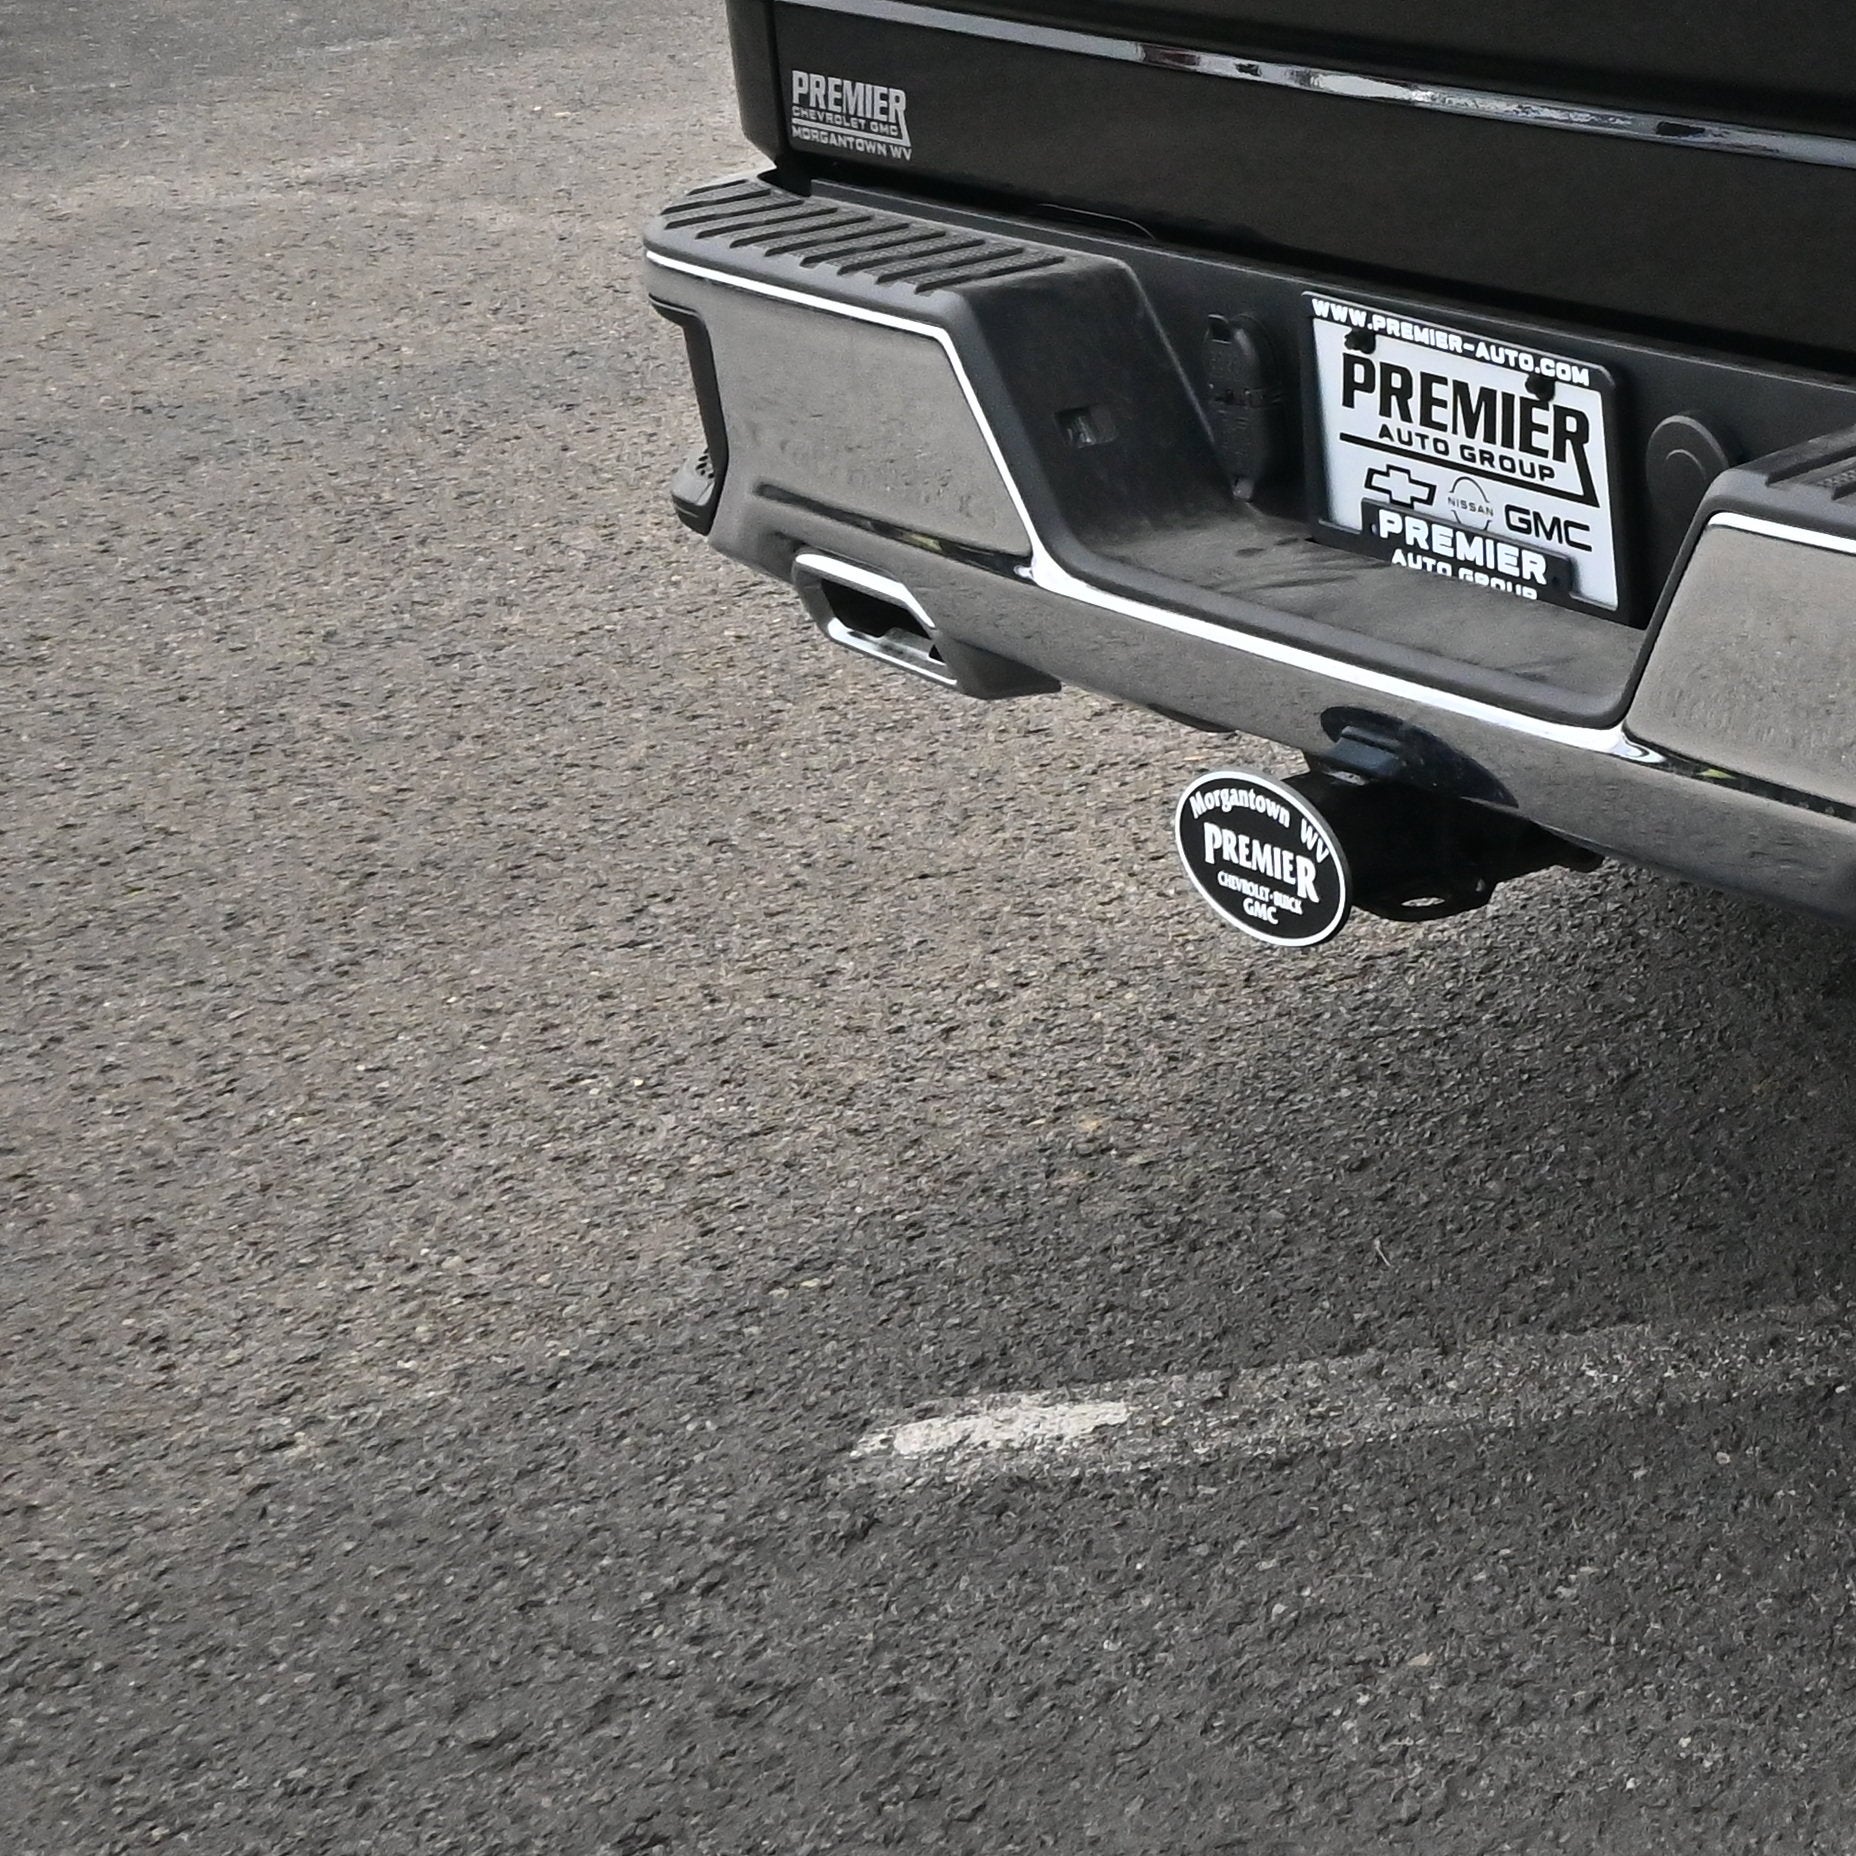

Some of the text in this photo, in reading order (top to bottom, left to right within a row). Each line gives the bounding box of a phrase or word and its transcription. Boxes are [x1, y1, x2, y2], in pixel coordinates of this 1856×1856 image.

[792, 70, 908, 129] PREMIER
[792, 105, 900, 137] CHEVROLET GMC
[791, 125, 912, 161] MORGANTOWN WV
[1311, 298, 1590, 387] WWW.PREMIER-AUTO.COM
[1342, 352, 1597, 484] PREMIER
[1378, 423, 1556, 482] AUTO GROUP
[1447, 496, 1494, 517] NISSAN
[1504, 504, 1592, 552] GMC
[1378, 509, 1548, 585] PREMIER
[1391, 548, 1453, 577] AUTO
[1189, 787, 1330, 864] Morgantown WV
[1203, 822, 1320, 904] PREMIER
[1242, 897, 1279, 925] GMC
